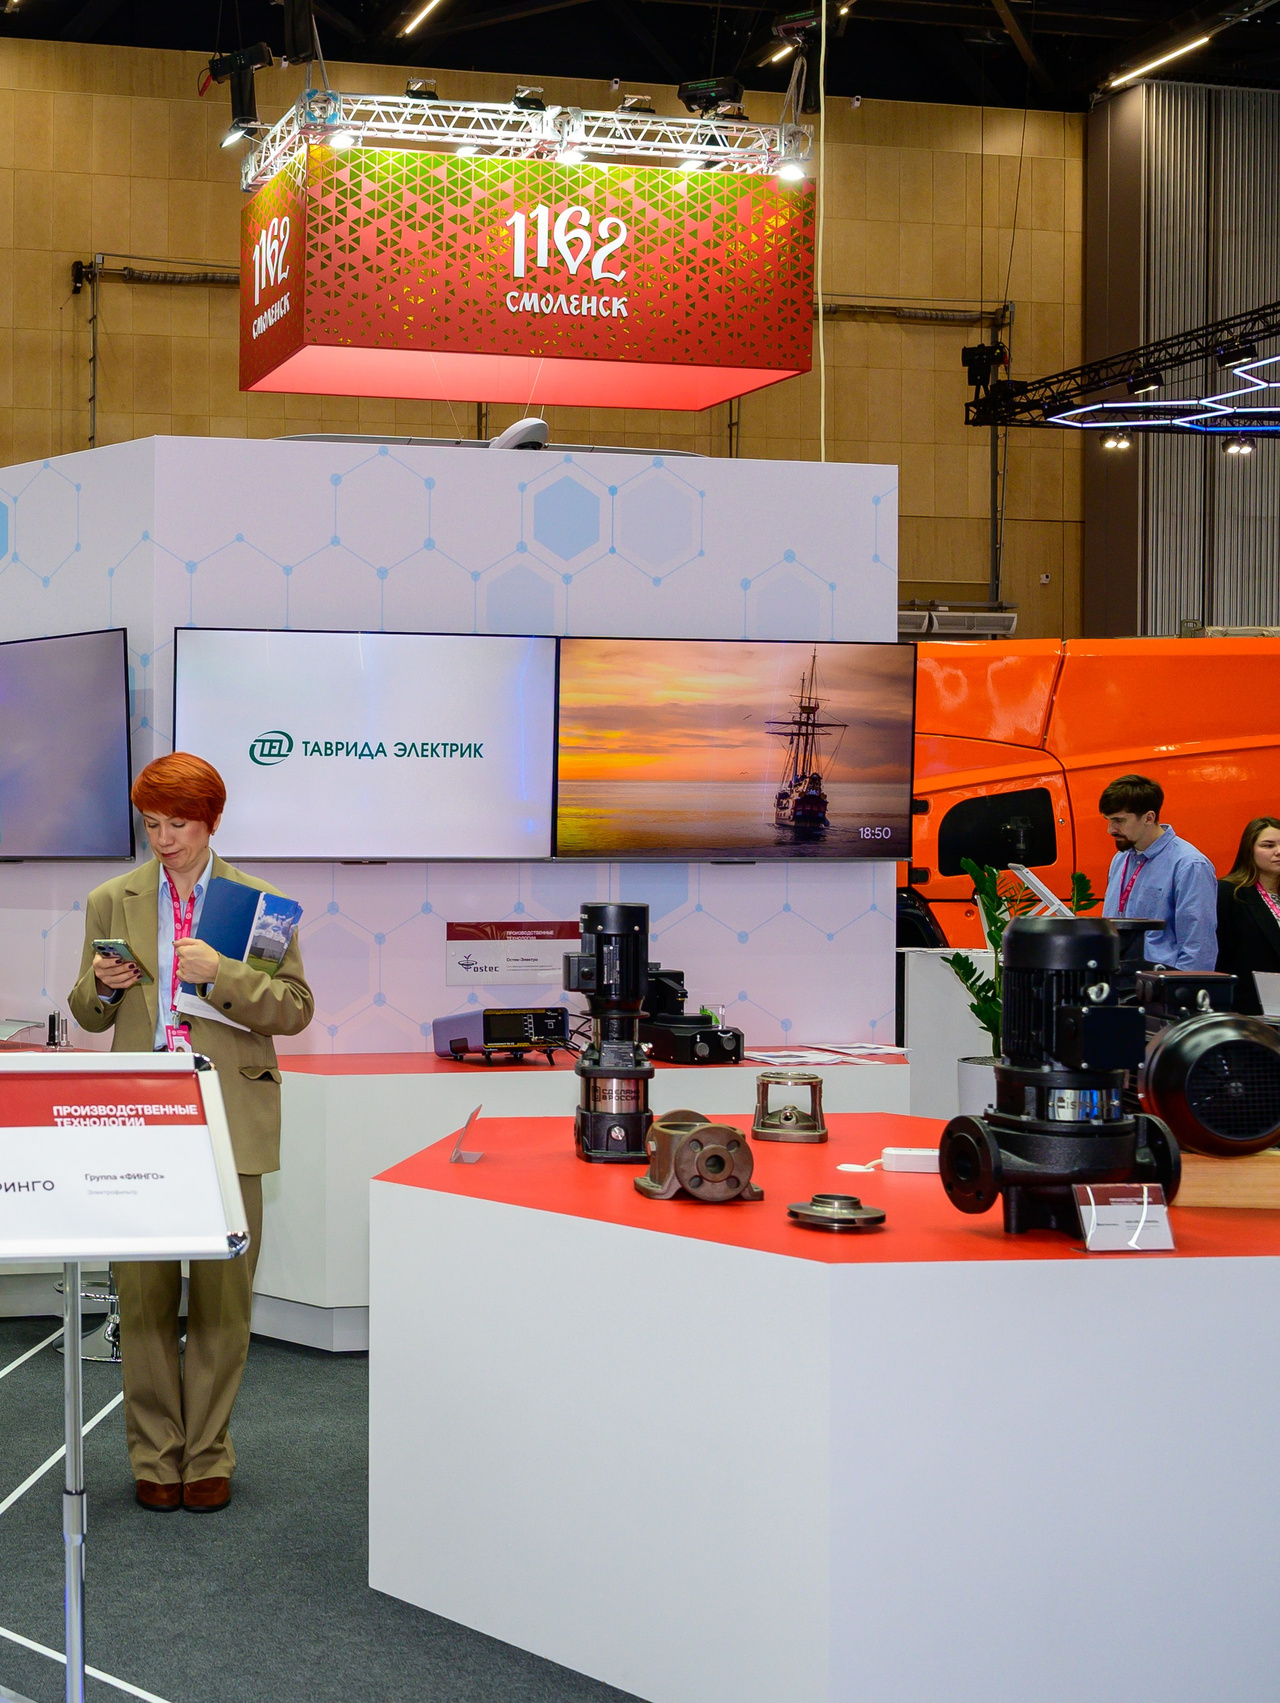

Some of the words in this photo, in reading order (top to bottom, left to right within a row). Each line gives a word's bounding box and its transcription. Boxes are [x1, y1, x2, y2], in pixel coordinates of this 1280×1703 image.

[505, 203, 628, 282] 1162
[252, 216, 290, 306] 1162
[506, 291, 628, 317] СМОЛЕНСК
[252, 292, 290, 340] СМОЛЕНСК
[302, 741, 387, 759] ТАВРИДА
[393, 742, 484, 758] ЭЛЕКТРИК
[859, 827, 892, 839] 18:50
[53, 1104, 199, 1117] ПРОИЗВОДСТВЕННЫЕ
[54, 1117, 146, 1127] ТЕХНОЛОГИИ
[85, 1173, 117, 1182] Группа
[120, 1172, 165, 1181] «ФИНГО»
